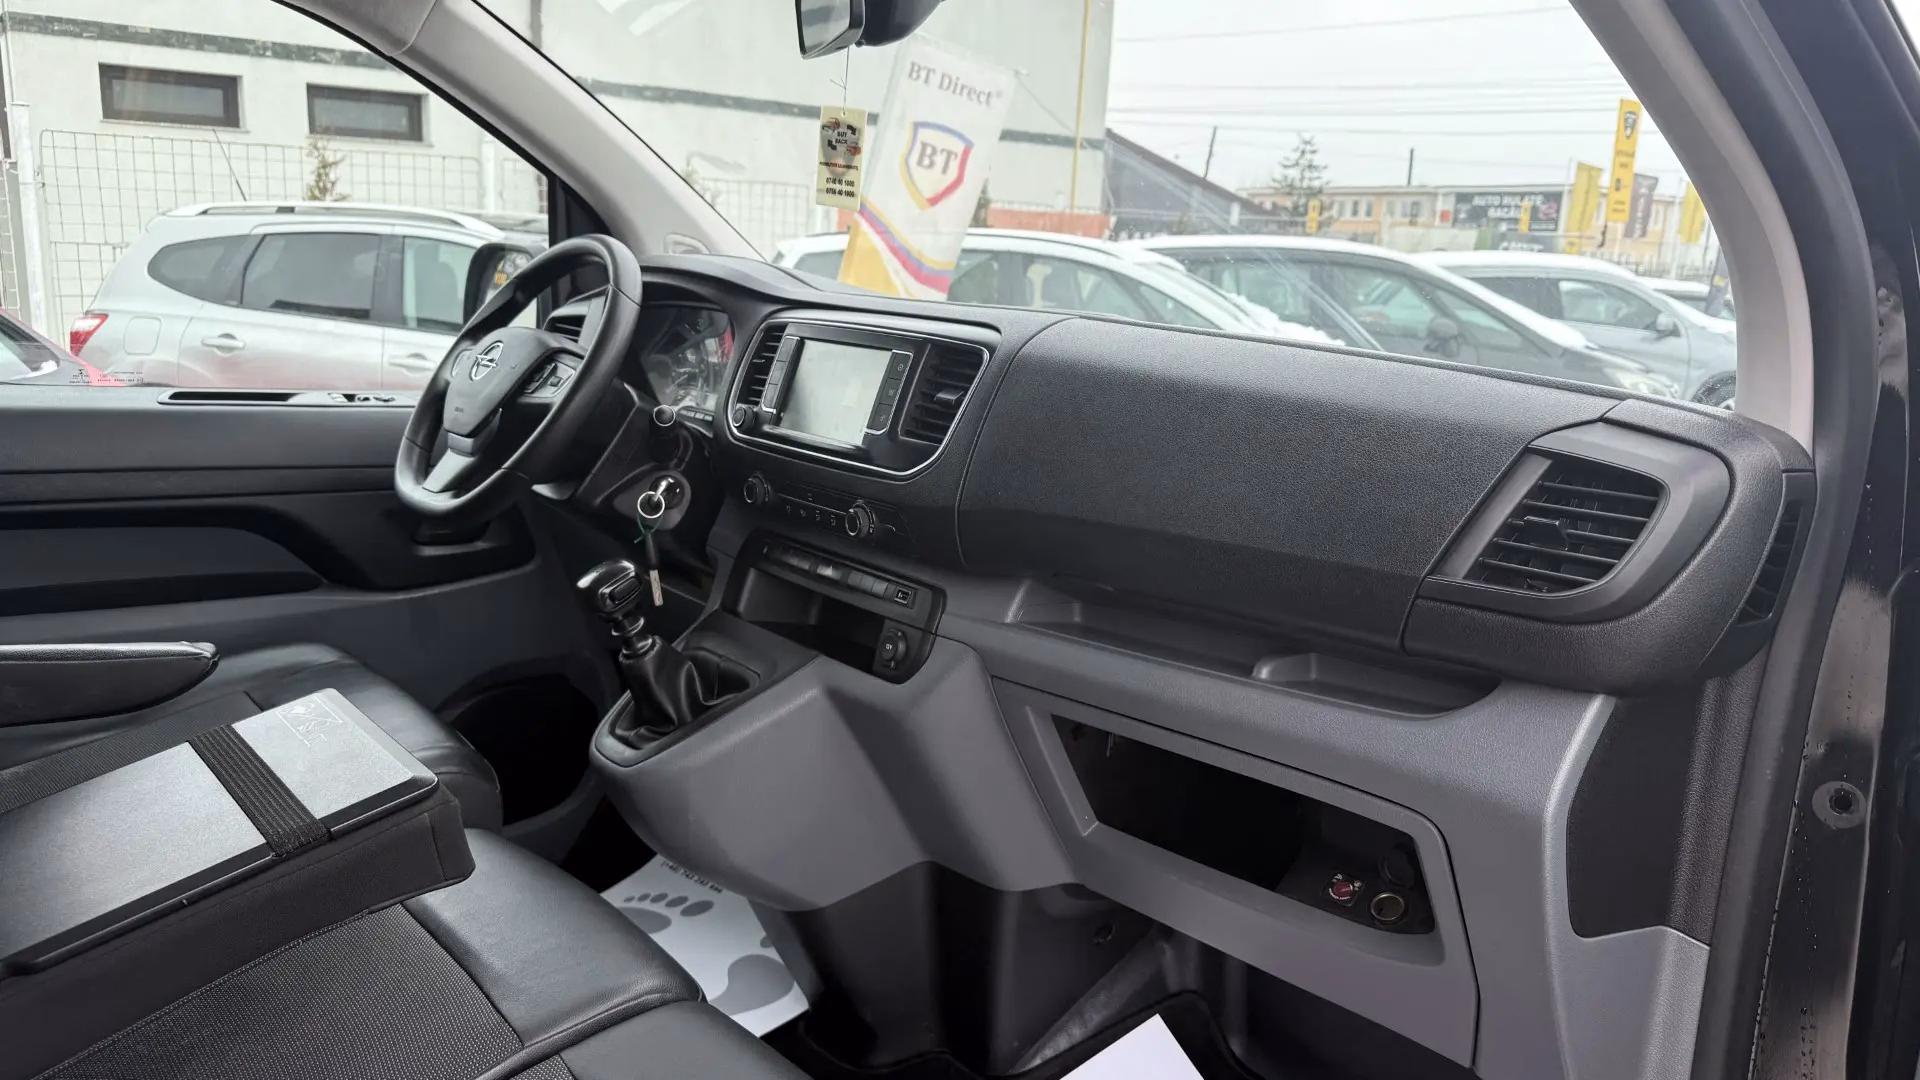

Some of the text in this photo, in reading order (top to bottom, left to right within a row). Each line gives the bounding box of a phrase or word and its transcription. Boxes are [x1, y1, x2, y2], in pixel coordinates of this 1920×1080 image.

[908, 61, 992, 106] BT Direct
[916, 140, 958, 175] BT
